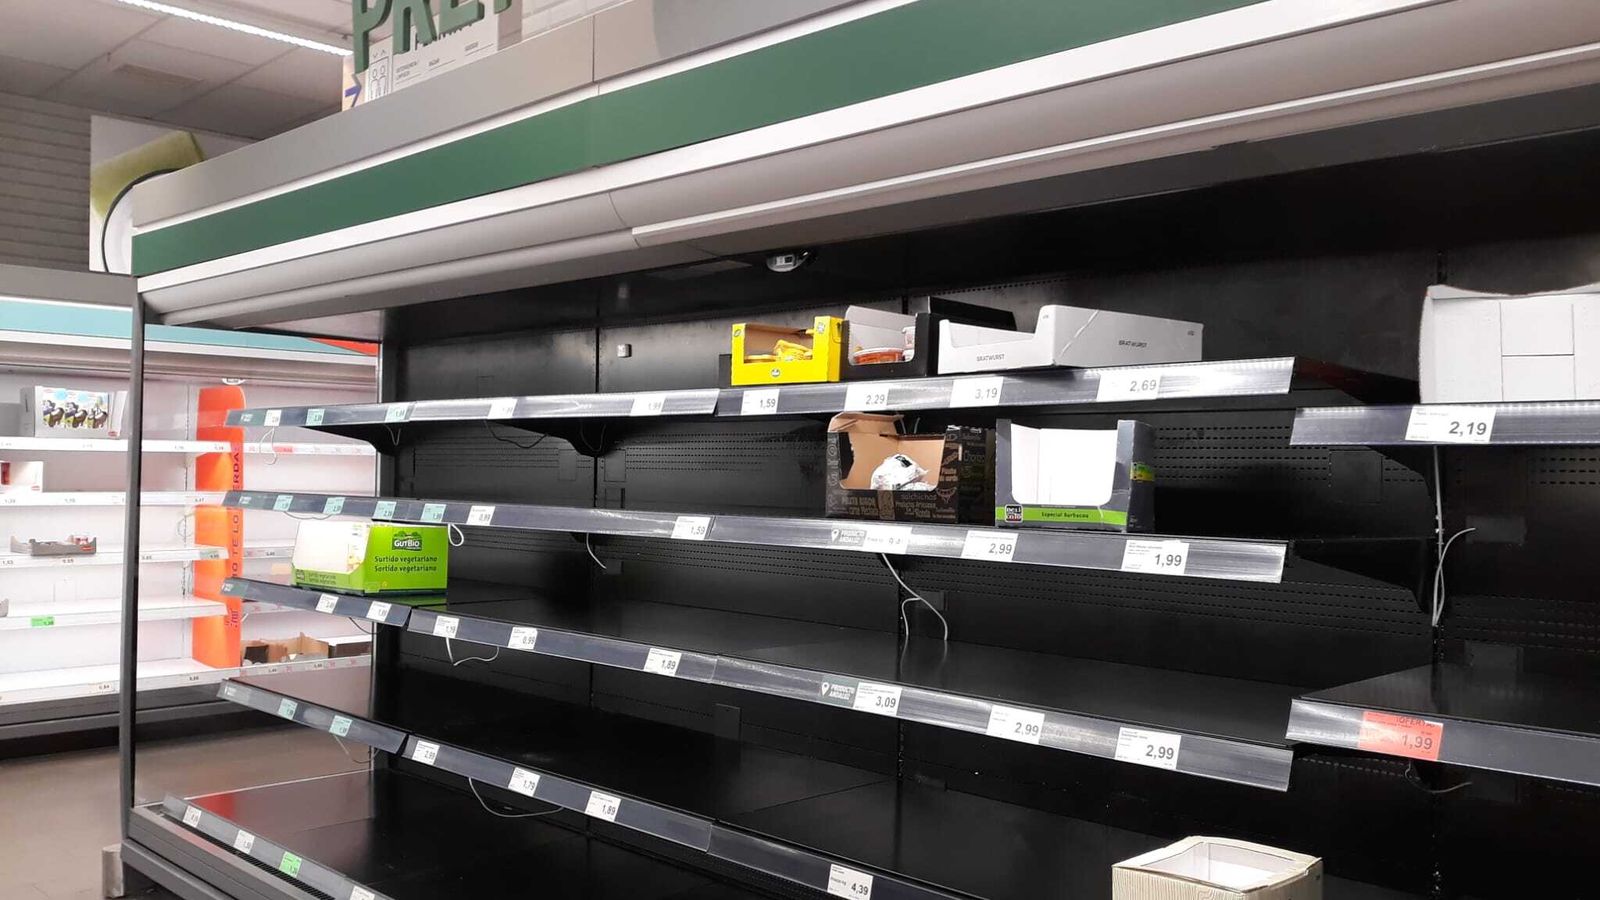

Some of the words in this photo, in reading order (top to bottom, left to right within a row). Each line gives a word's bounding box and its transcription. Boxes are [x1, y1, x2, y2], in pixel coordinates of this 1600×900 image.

[1129, 379, 1157, 392] 2,69
[975, 387, 998, 401] 3,19
[759, 398, 776, 410] 1,59
[1448, 420, 1488, 438] 2,19
[988, 543, 1013, 555] 2,99
[375, 555, 399, 563] Surtido
[399, 555, 438, 565] vegetariano
[1155, 553, 1183, 568] 1,99
[375, 565, 398, 573] Sortido
[399, 565, 438, 574] vegetariano
[875, 695, 897, 708] 3,09
[1014, 721, 1040, 737] 2,99
[1402, 734, 1433, 750] 1,99
[1145, 744, 1175, 761] 2,99
[850, 882, 869, 896] 4,39
